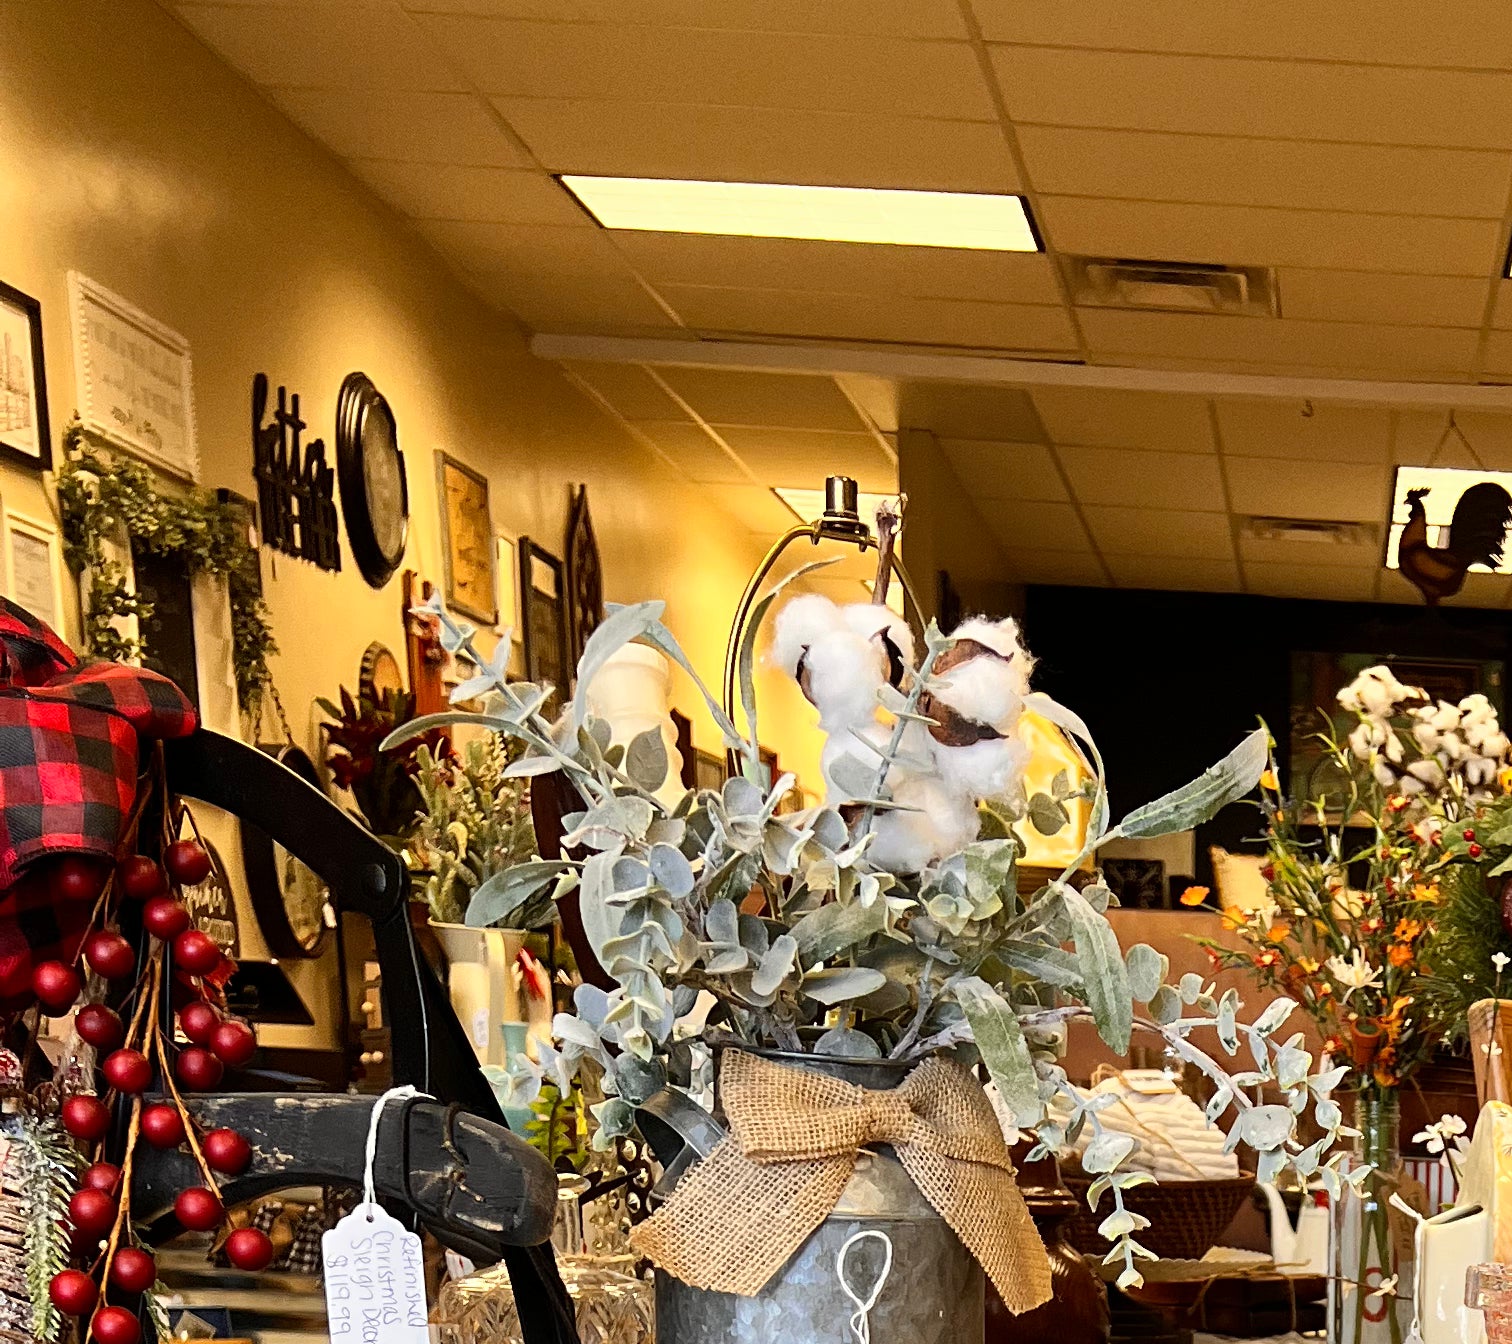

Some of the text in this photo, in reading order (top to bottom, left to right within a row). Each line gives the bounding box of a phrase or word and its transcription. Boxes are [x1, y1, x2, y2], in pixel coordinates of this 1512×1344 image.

[326, 1255, 352, 1336] $119.99
[351, 1236, 374, 1302] Sleigh
[371, 1230, 402, 1326] Christmas
[400, 1235, 428, 1328] Refinished
